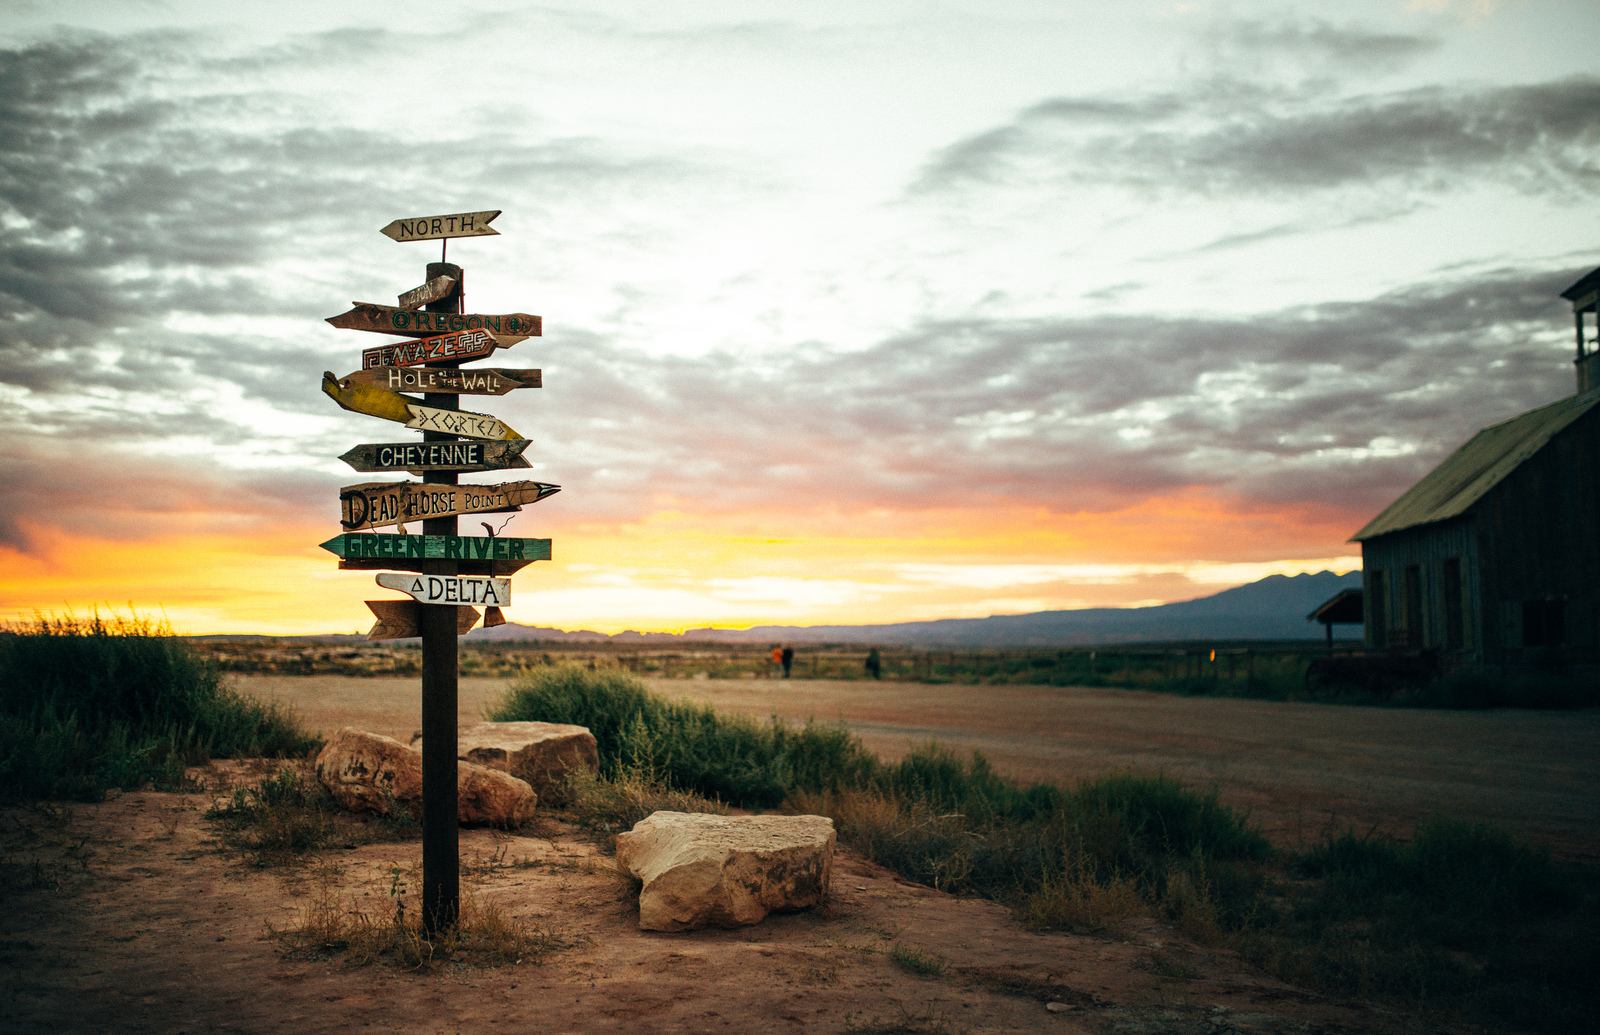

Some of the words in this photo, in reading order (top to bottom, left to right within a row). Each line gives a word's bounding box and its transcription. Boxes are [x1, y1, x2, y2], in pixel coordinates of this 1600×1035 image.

[401, 216, 475, 236] NORTH
[392, 311, 500, 333] OREGON
[392, 336, 456, 363] MAZE
[388, 369, 436, 388] HOLE
[441, 378, 459, 387] THE
[461, 372, 500, 392] WALL
[430, 411, 496, 437] CORTEZ
[380, 444, 478, 467] CHEYENNE
[340, 490, 399, 529] DEAD
[408, 491, 456, 517] HORSE
[464, 493, 503, 510] POINT
[344, 534, 425, 559] GREEN
[445, 536, 525, 560] RIVER
[428, 577, 499, 604] DELTA
